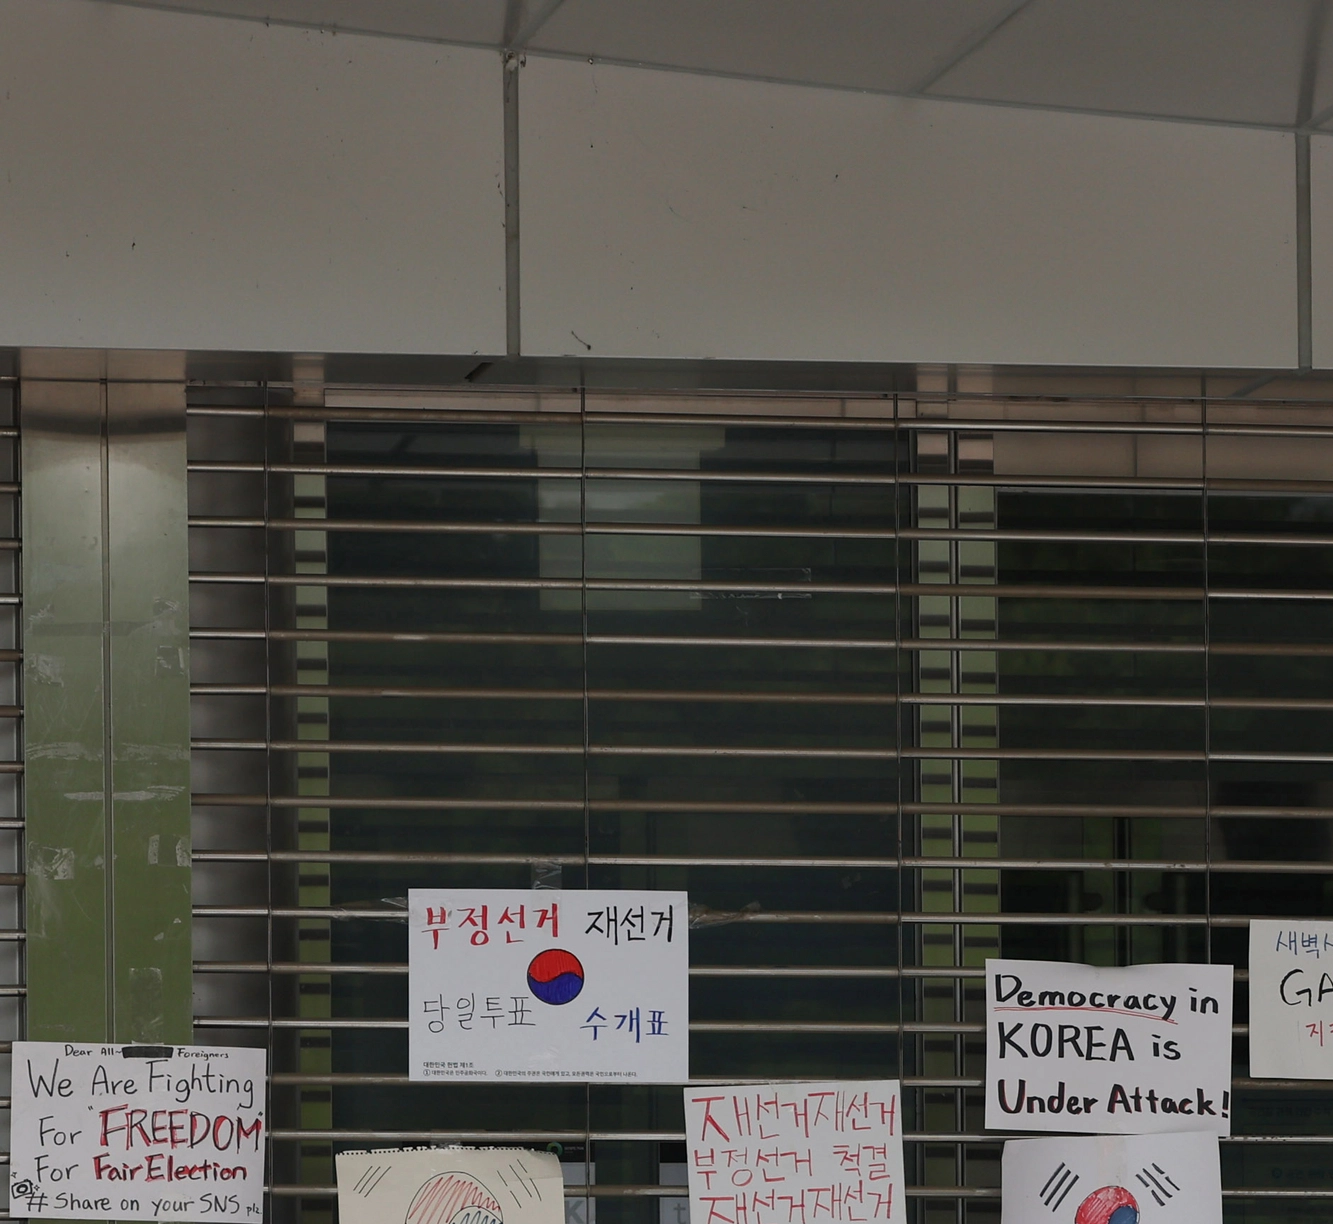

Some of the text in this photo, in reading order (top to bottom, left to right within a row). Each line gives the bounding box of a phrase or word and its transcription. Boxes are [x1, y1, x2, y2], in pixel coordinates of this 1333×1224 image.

[421, 903, 674, 950] 부정선거 재선거
[423, 992, 669, 1043] 당일투표 수개표
[994, 973, 1219, 1022] Democracy in
[65, 1044, 229, 1059] Dear Foreigners
[999, 1022, 1182, 1062] KOREA is
[27, 1058, 254, 1109] We Are Fighting
[998, 1079, 1230, 1120] Under Attack!
[39, 1116, 82, 1146] For
[692, 1091, 896, 1142] 재선거재선거
[35, 1152, 247, 1182] For Fair Election
[694, 1143, 890, 1189] 부정선거 척결
[54, 1193, 112, 1210] Share
[120, 1198, 140, 1212] on
[151, 1198, 195, 1216] your
[200, 1193, 240, 1213] SNS
